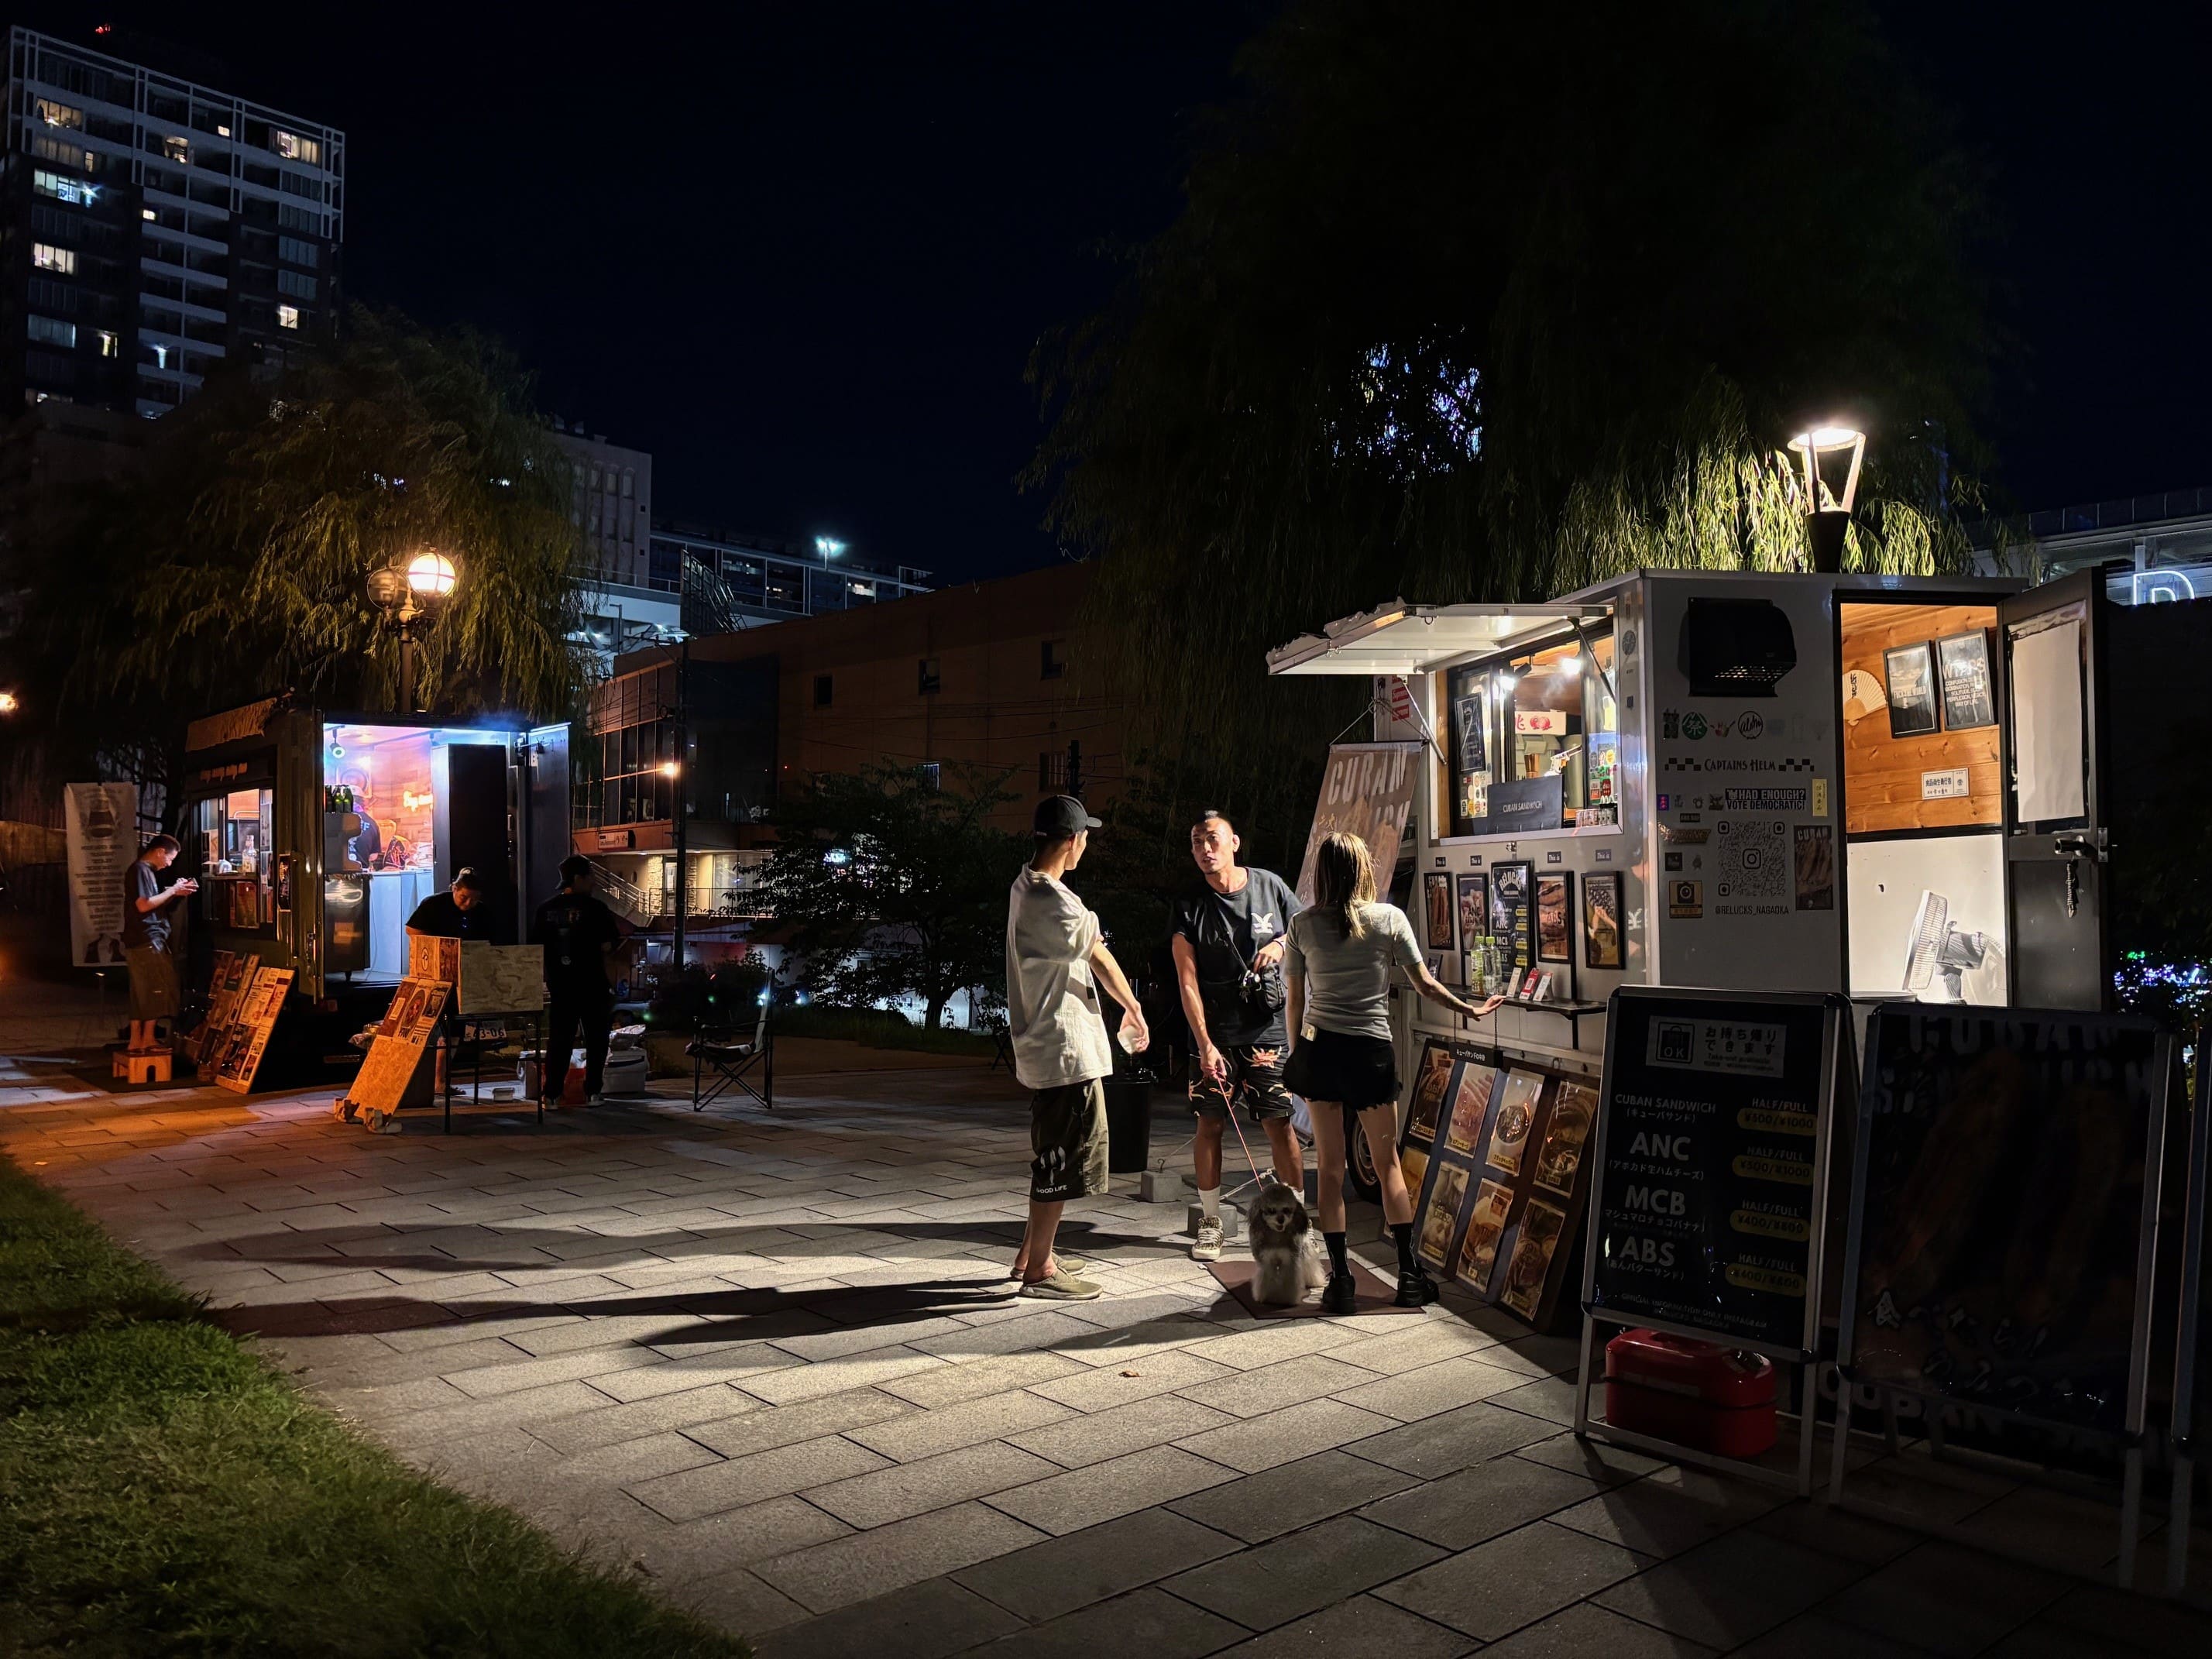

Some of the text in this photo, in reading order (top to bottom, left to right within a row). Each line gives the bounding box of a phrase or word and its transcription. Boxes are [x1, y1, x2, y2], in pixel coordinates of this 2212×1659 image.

[1328, 745, 1407, 805] CUBAN
[1740, 789, 1805, 801] HAD ENOUGH?
[1503, 800, 1542, 813] CUBAN SANDWICH
[1727, 800, 1805, 811] VOTE DEMOCRATIC!
[1706, 1026, 1777, 1042] お持ち帰り
[1664, 1046, 1685, 1059] OK
[1705, 1039, 1774, 1054] できます
[1614, 1094, 1717, 1115] CUBAN SANDWICH
[1751, 1097, 1808, 1113] HALF/FULL
[1629, 1130, 1692, 1162] ANC
[1747, 1146, 1804, 1162] HALF/FULL
[1624, 1184, 1686, 1216] MCB
[1741, 1199, 1800, 1218] HALF/FULL
[1619, 1235, 1676, 1267] ABS
[1738, 1253, 1798, 1273] HALF/FULL
